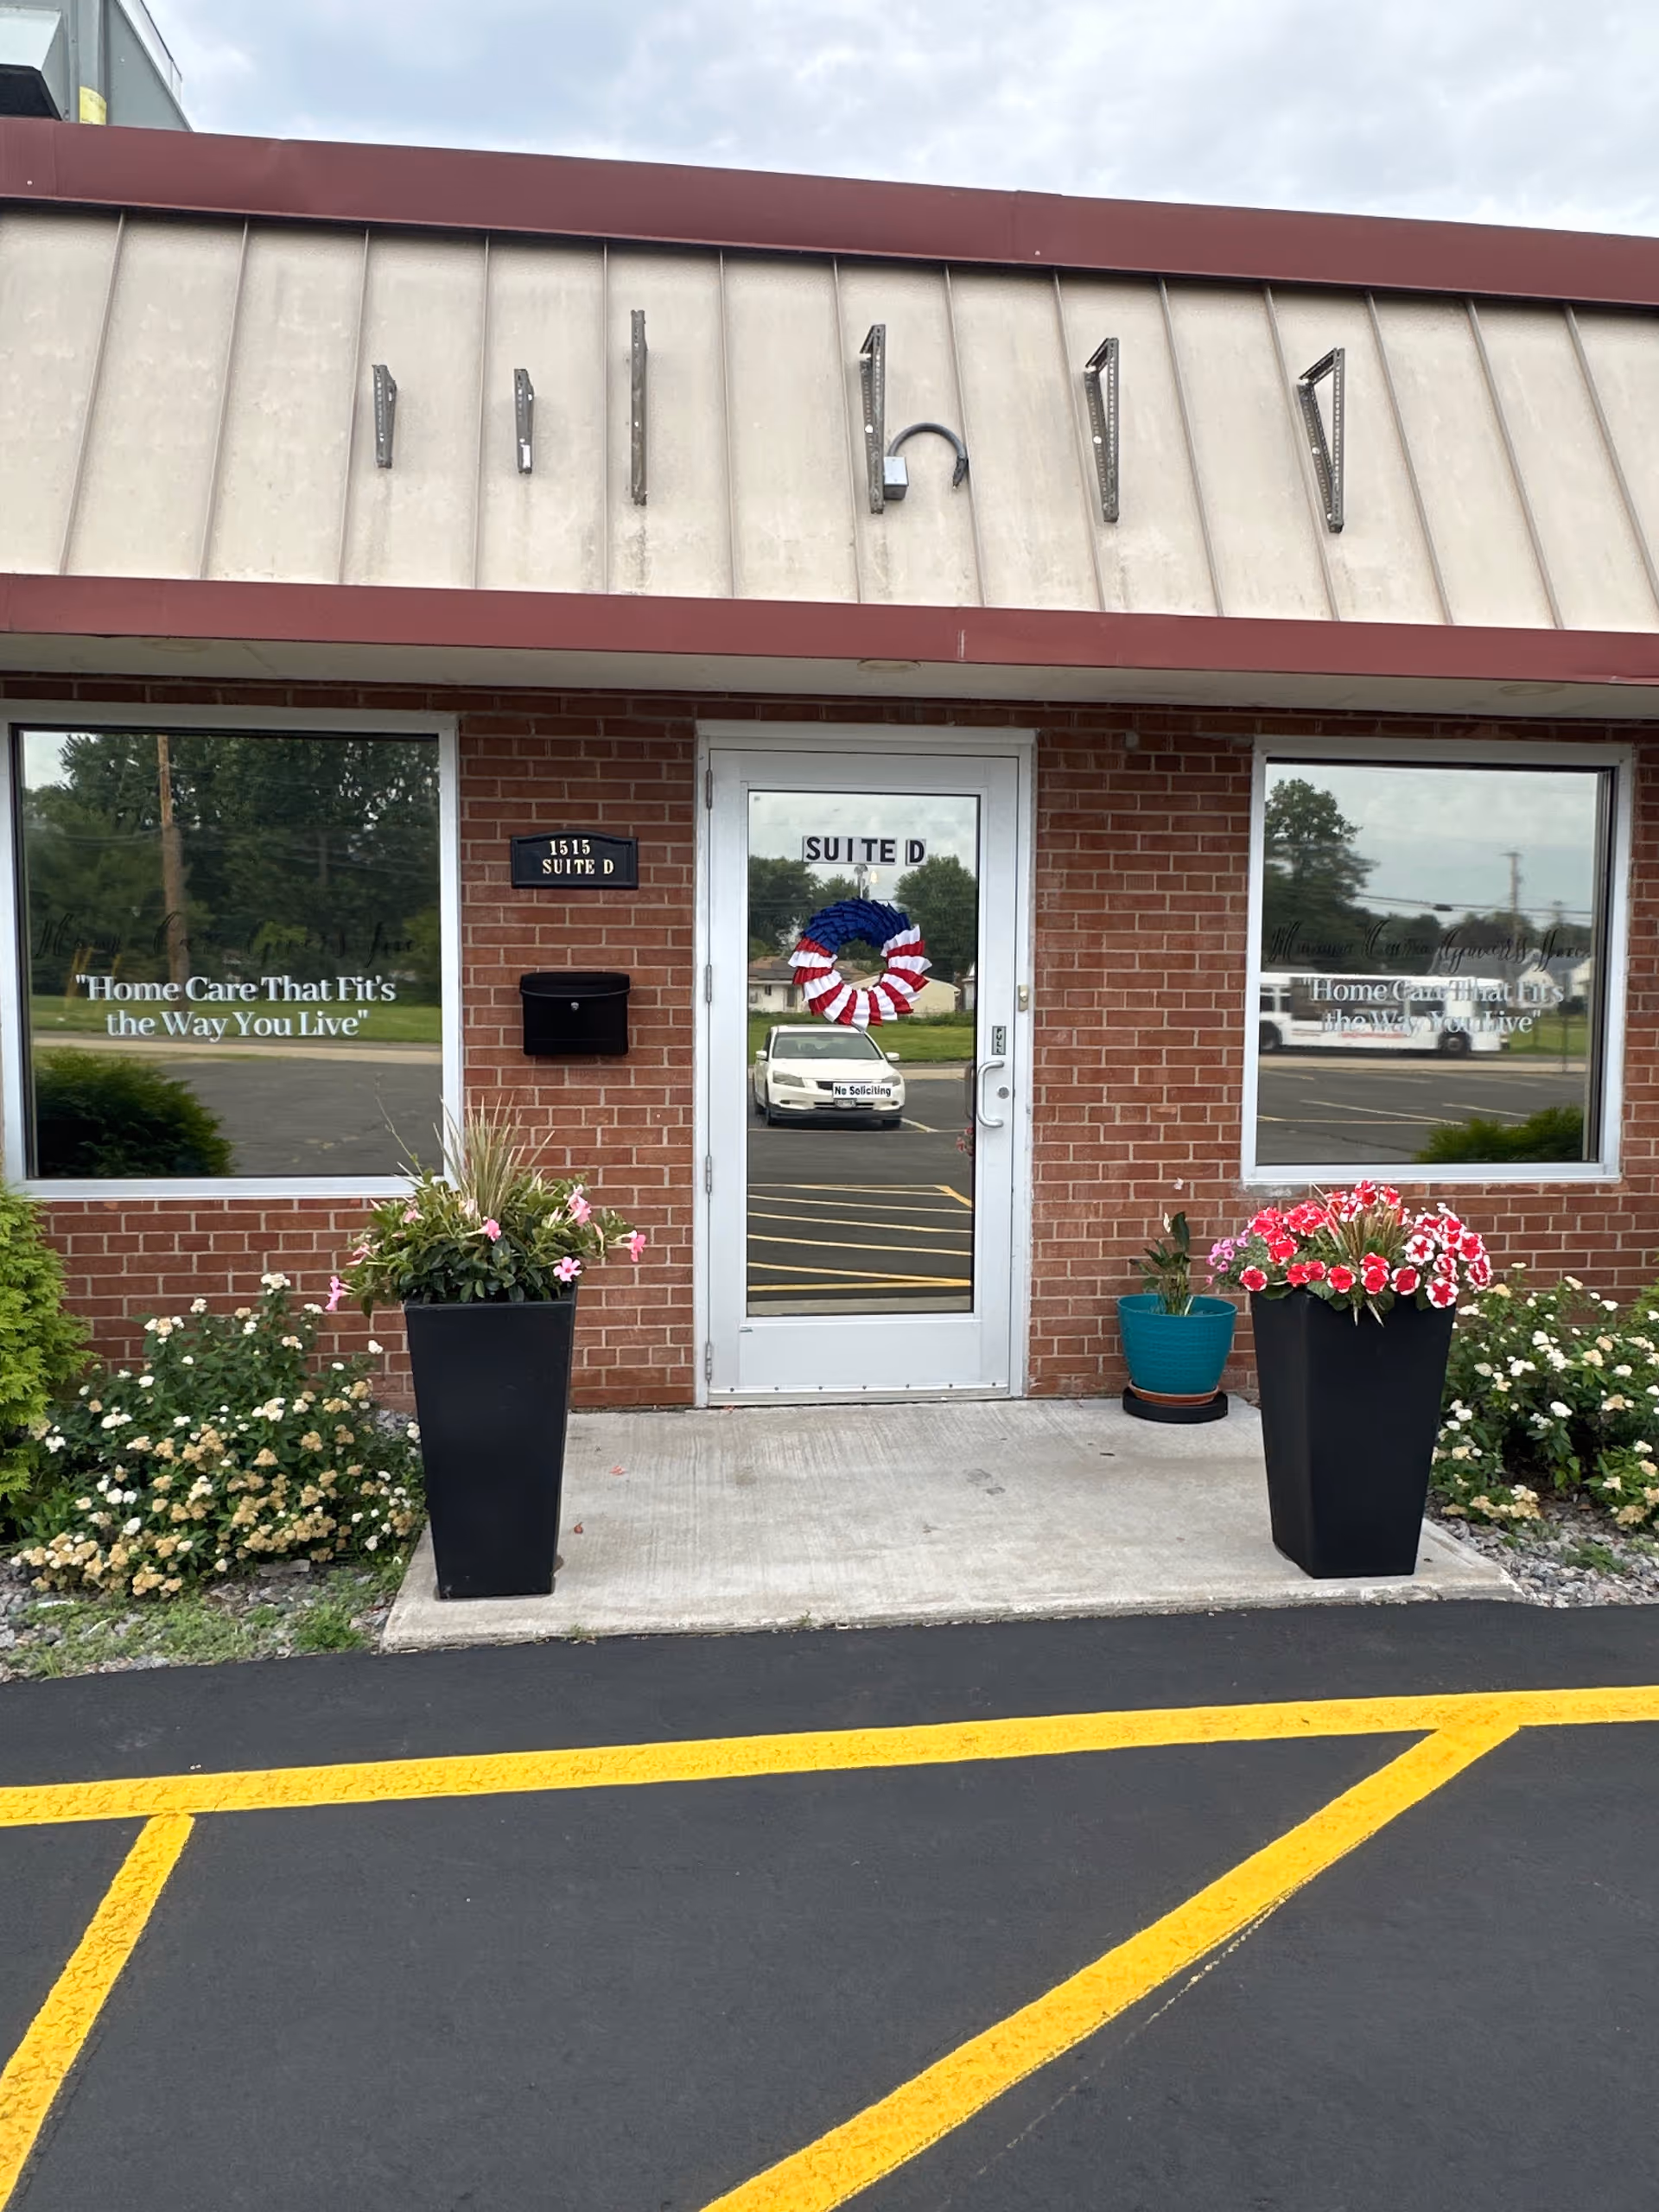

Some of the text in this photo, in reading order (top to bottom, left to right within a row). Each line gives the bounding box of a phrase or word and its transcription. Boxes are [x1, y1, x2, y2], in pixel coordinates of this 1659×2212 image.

[550, 839, 591, 855] 1515
[805, 836, 925, 863] SUITE D
[542, 859, 614, 874] SUITE D
[75, 975, 396, 1001] "Home Care That Fit's
[1303, 977, 1387, 1002] "Home
[1449, 979, 1513, 1003] That
[1517, 979, 1565, 1003] Fit's
[107, 1010, 369, 1042] the Way You Live"
[1325, 1009, 1541, 1039] the Way You Live"
[835, 1085, 892, 1097] No Soliciting
